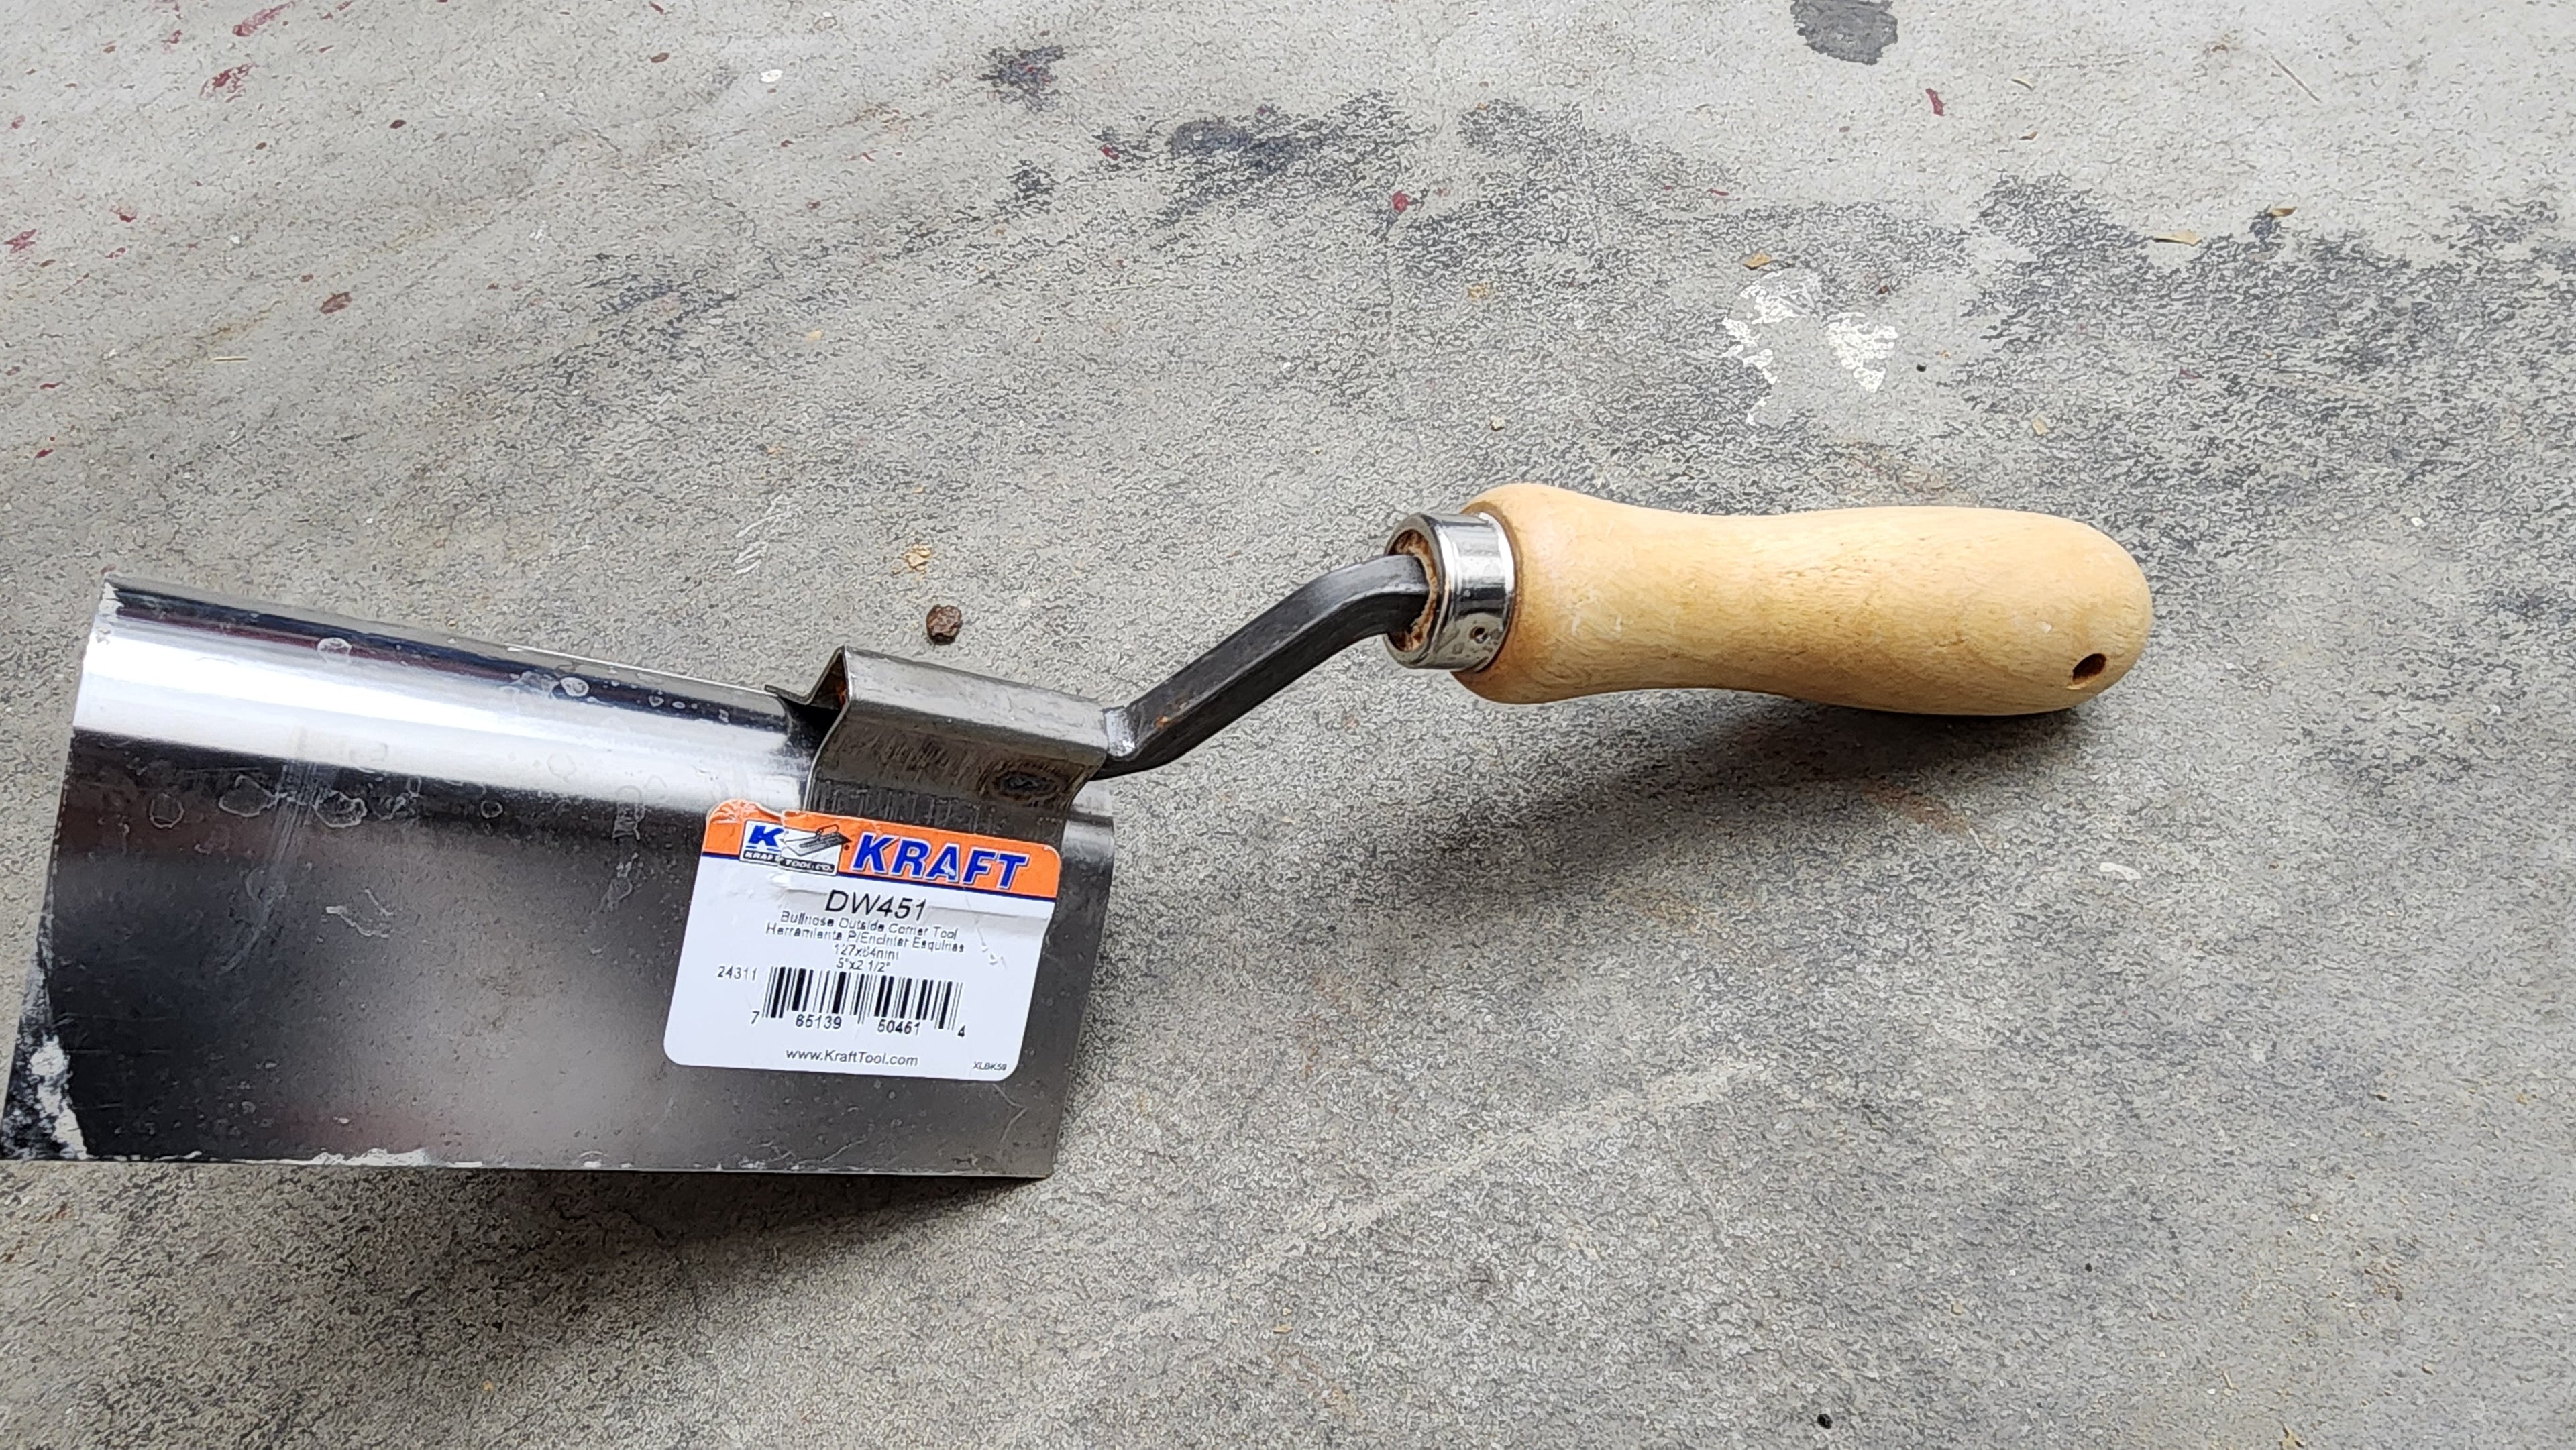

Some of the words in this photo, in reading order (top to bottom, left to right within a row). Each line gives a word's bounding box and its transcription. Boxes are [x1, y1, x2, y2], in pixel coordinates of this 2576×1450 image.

[747, 824, 784, 848] K
[852, 832, 1029, 889] KRAFT
[824, 889, 927, 922] DW451
[780, 909, 835, 927] Bullnose
[839, 917, 885, 932] Outside
[888, 923, 929, 937] Corner
[933, 927, 959, 940] Tool
[717, 965, 757, 981] 24311
[751, 1011, 760, 1025] 7
[957, 1024, 966, 1038] 4
[786, 1049, 919, 1067] www.KraftTool.com
